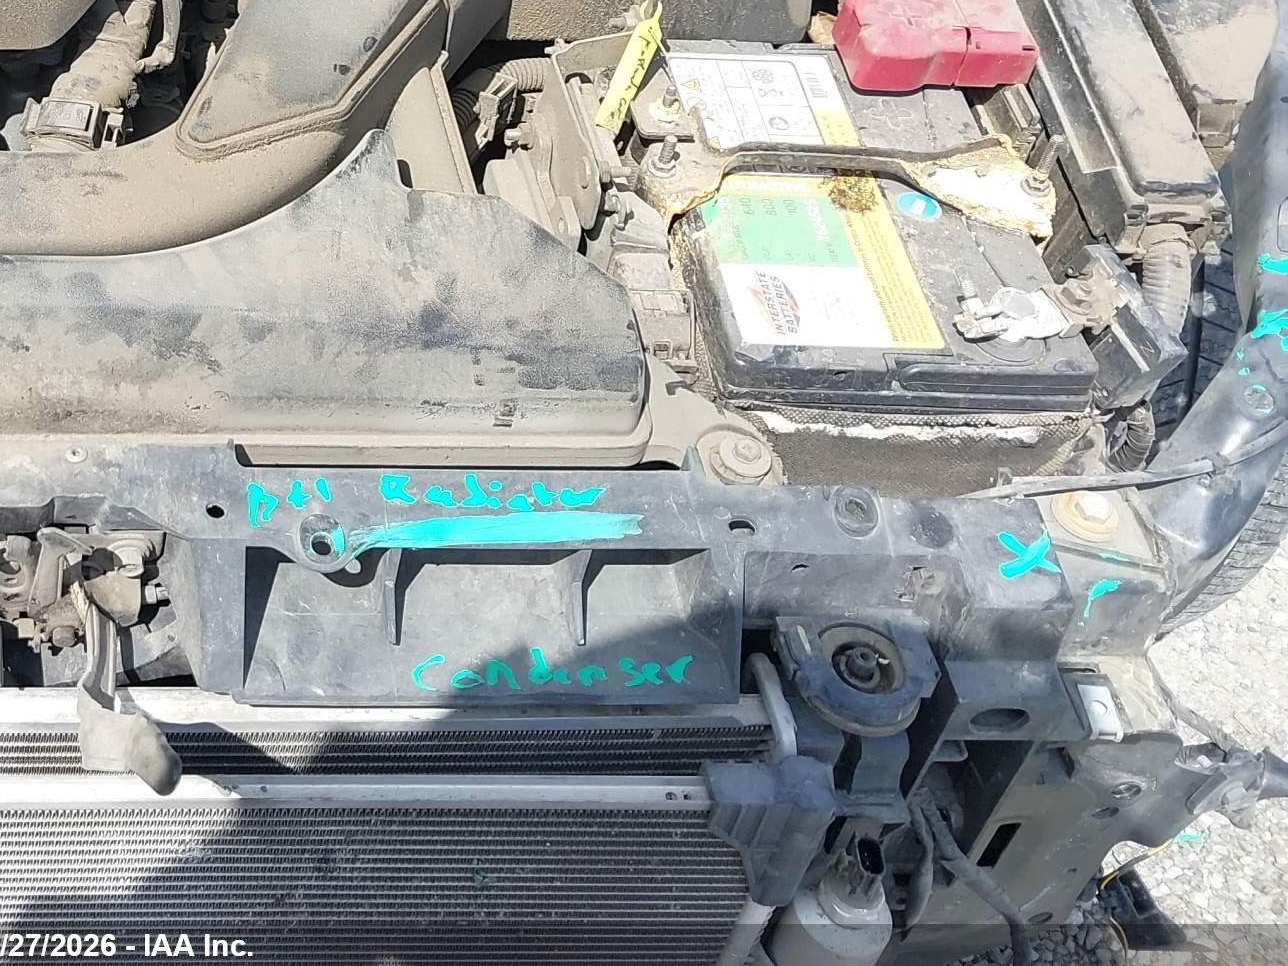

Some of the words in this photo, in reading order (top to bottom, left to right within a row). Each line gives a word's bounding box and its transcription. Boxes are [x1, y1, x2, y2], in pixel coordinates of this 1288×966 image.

[754, 270, 786, 336] INTERSTATE
[769, 274, 799, 335] BATTERIES
[379, 473, 608, 511] Radiator
[411, 646, 694, 691] Condenser
